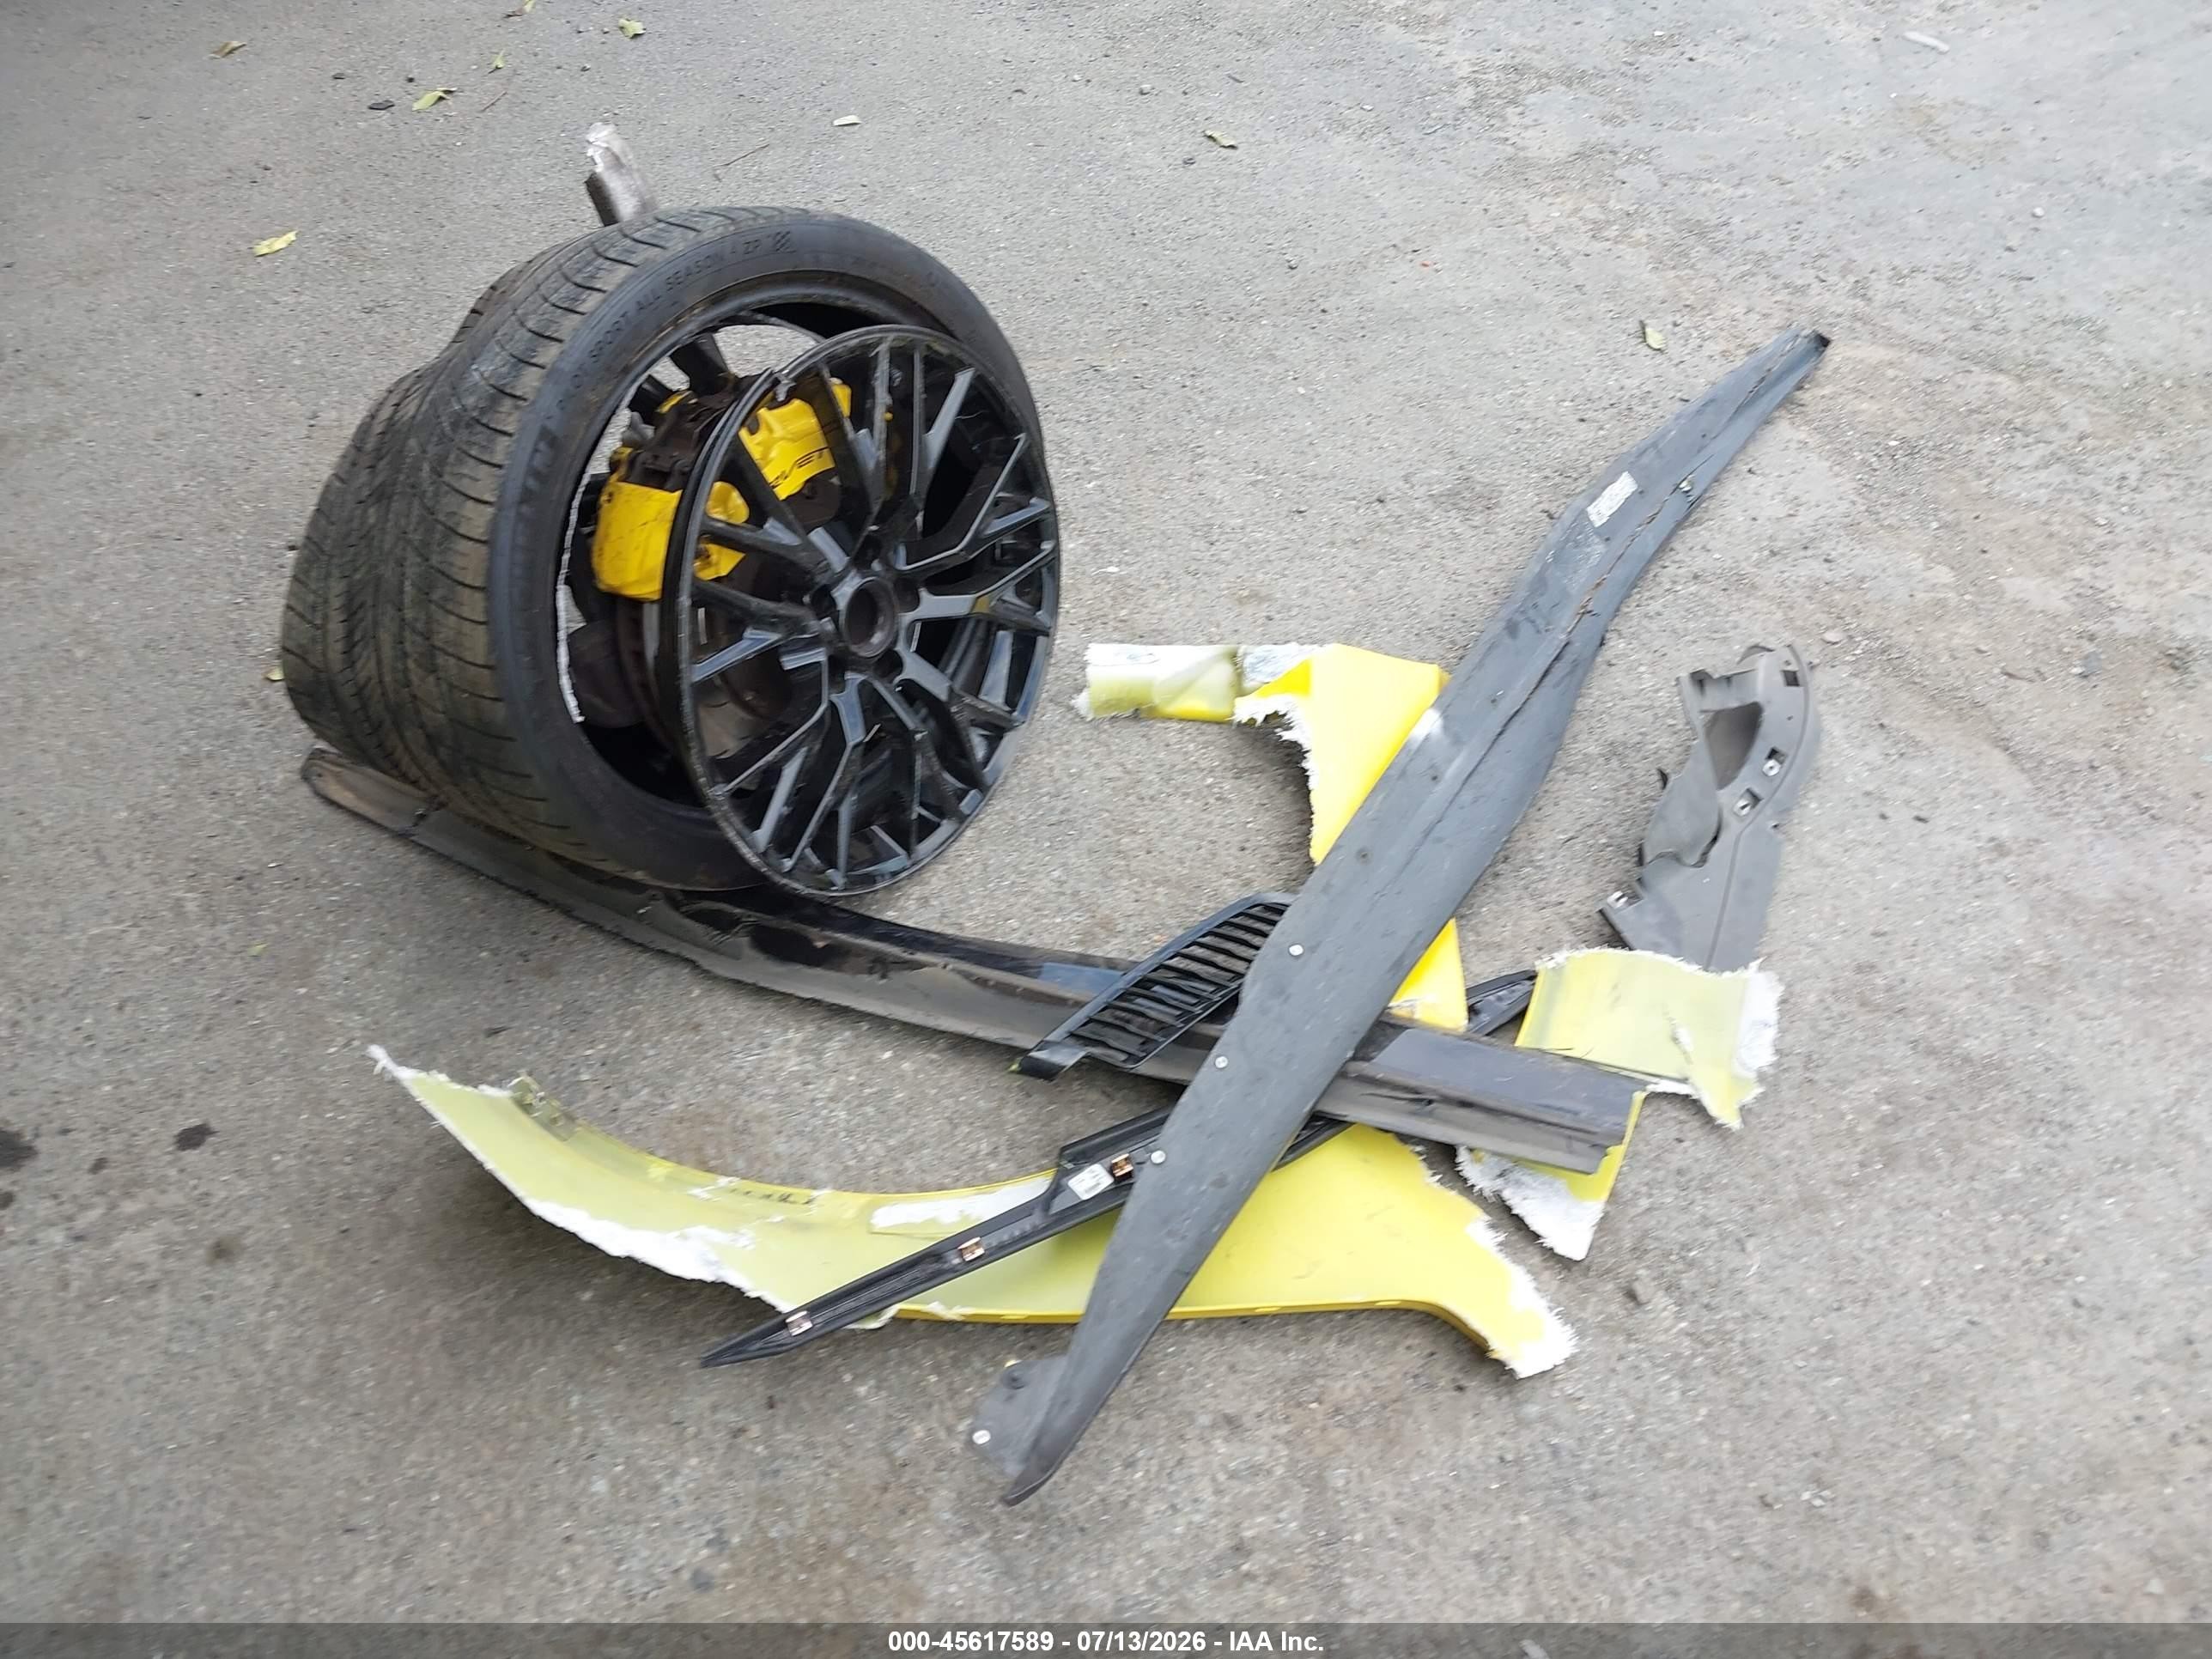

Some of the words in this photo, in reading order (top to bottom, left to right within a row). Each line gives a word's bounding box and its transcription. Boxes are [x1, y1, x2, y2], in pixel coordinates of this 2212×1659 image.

[589, 311, 630, 362] SPORT
[635, 289, 662, 313] ALL
[665, 251, 726, 292] SEASON
